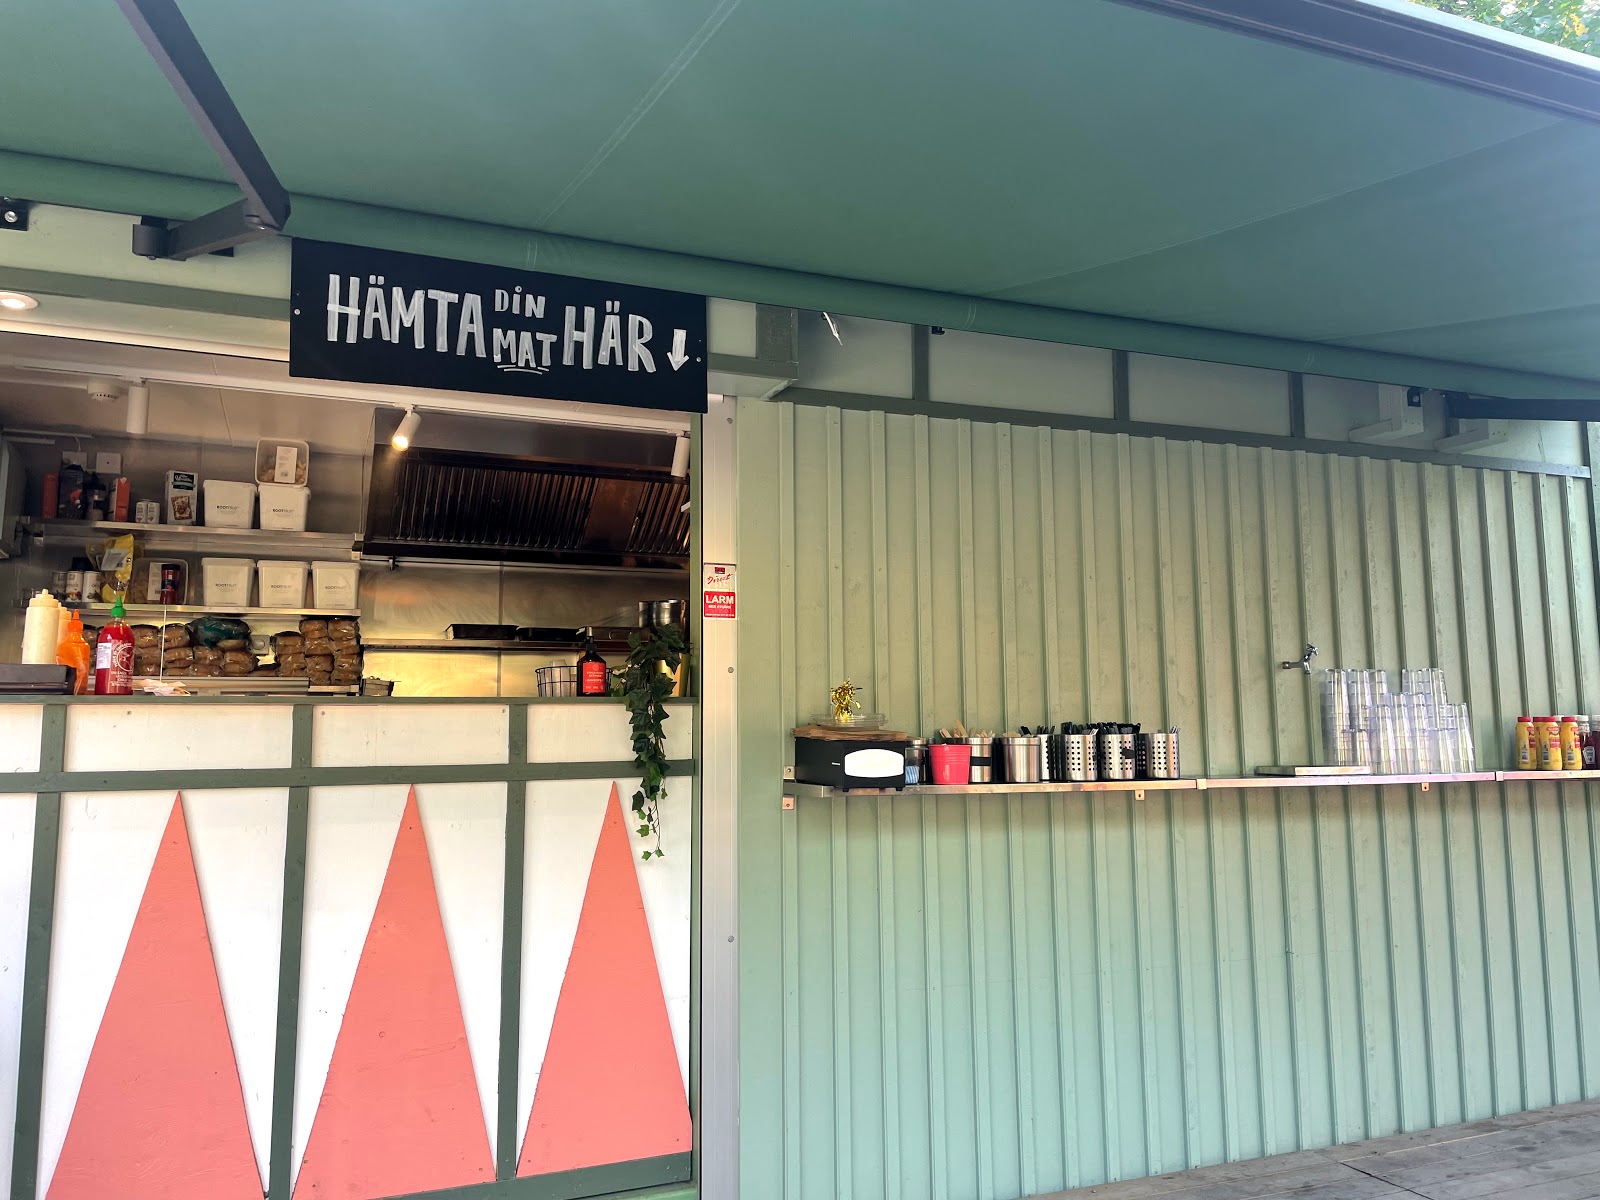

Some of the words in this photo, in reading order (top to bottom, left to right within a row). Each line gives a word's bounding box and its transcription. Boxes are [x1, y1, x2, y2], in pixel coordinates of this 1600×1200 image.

[327, 273, 486, 358] HÄMTA
[493, 328, 557, 367] MAT
[562, 300, 657, 373] HÄR
[705, 595, 734, 604] LARM
